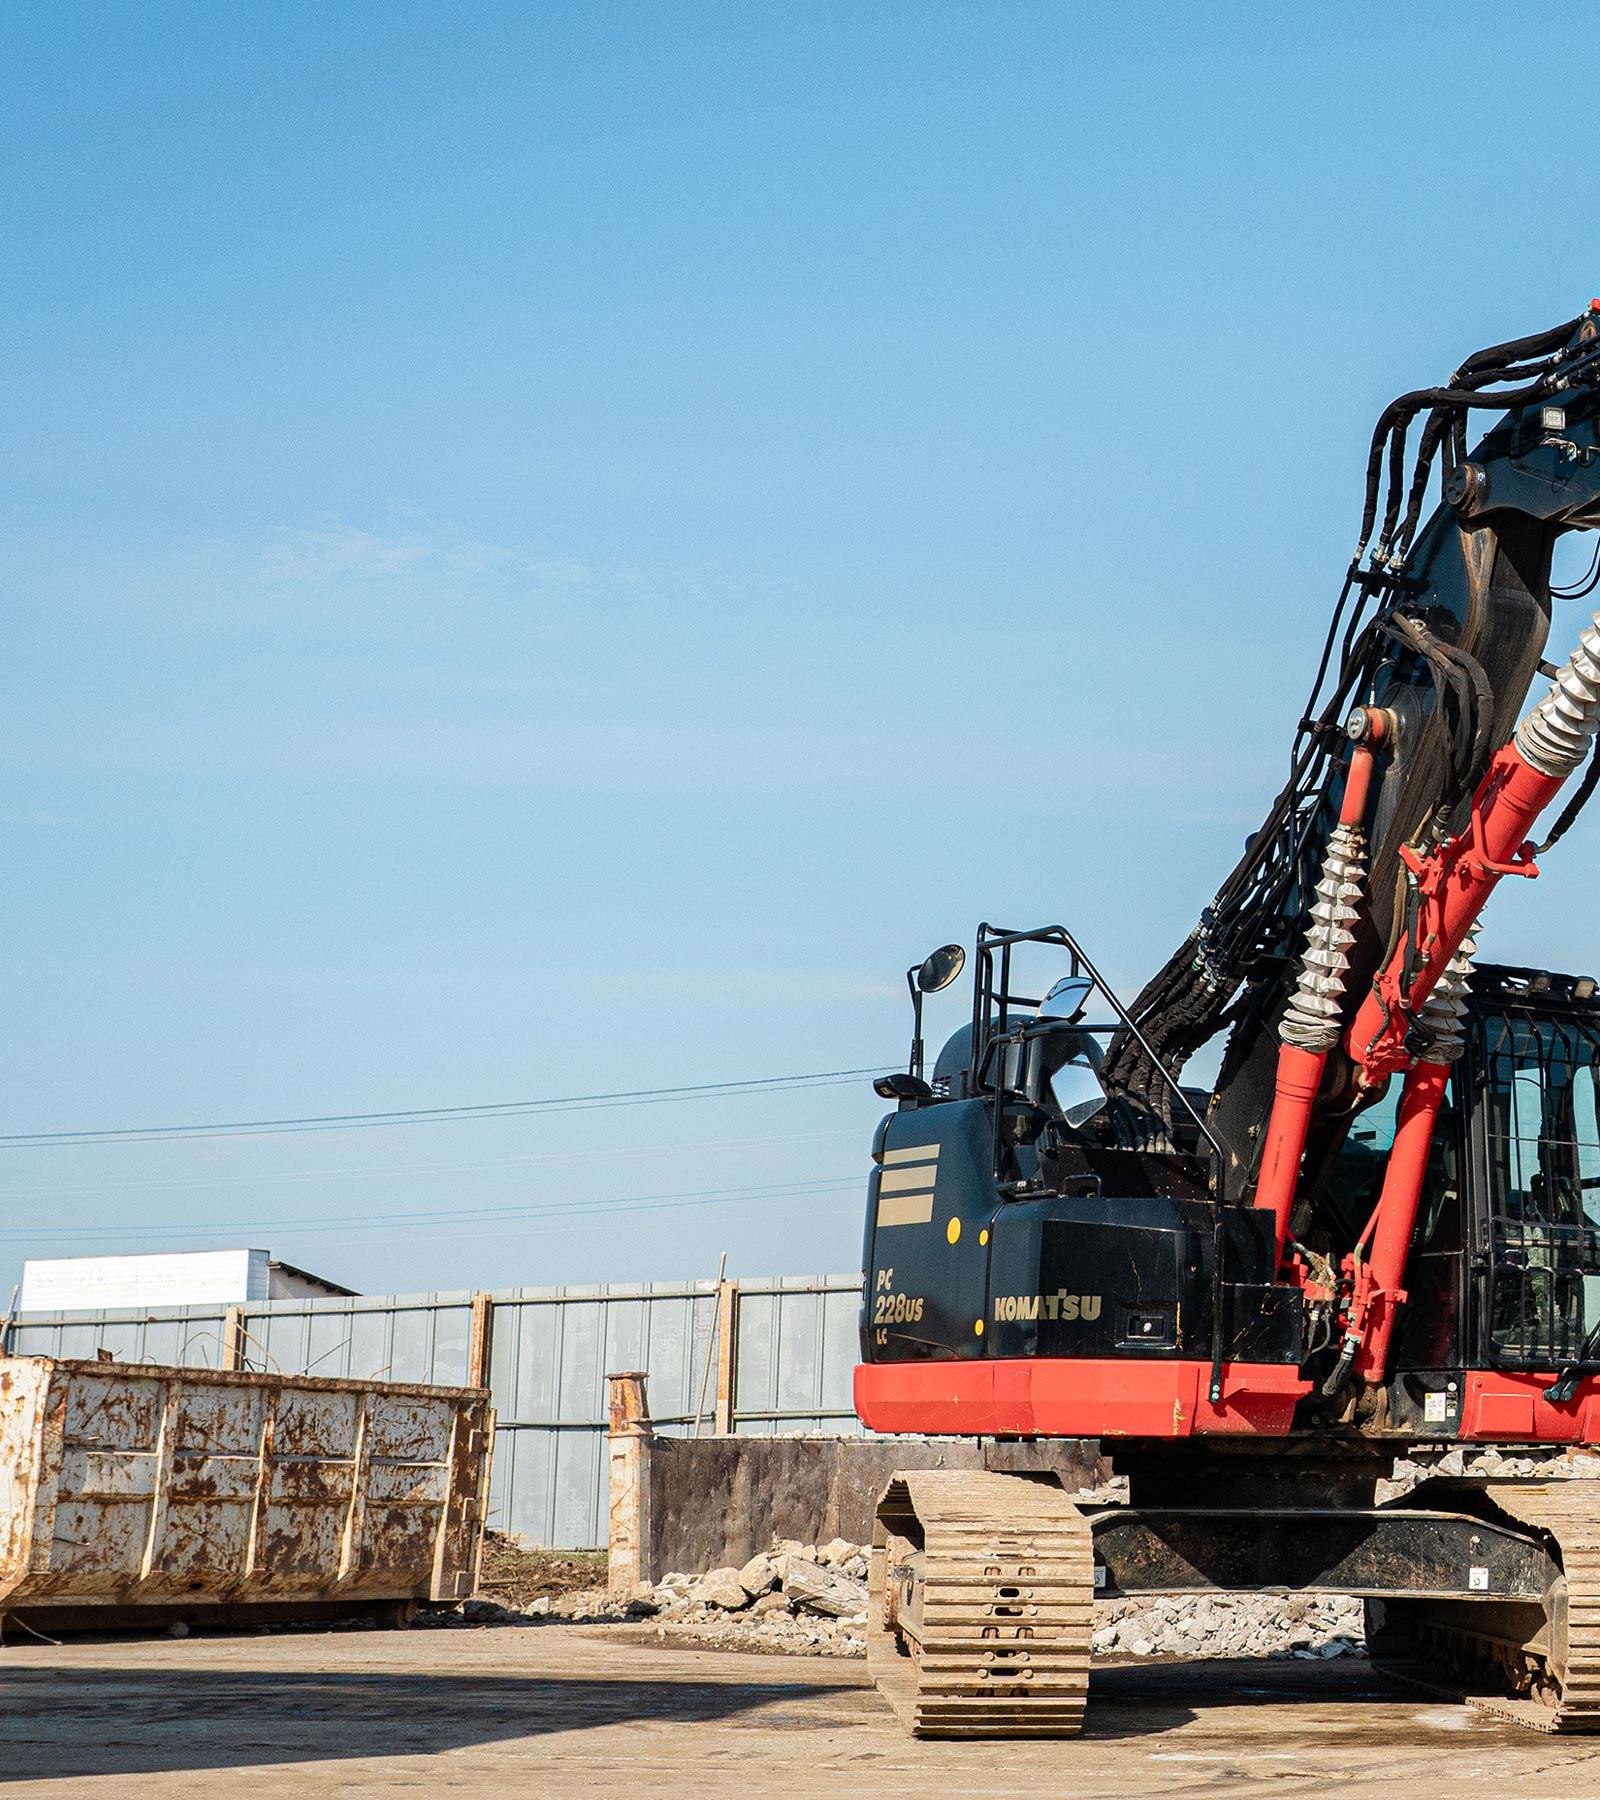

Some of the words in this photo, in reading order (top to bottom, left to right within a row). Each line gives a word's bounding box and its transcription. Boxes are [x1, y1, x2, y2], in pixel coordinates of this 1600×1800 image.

[876, 1268, 893, 1292] PC
[874, 1293, 924, 1324] 228US
[994, 1288, 1102, 1321] KOMATSU
[876, 1328, 888, 1345] LC
